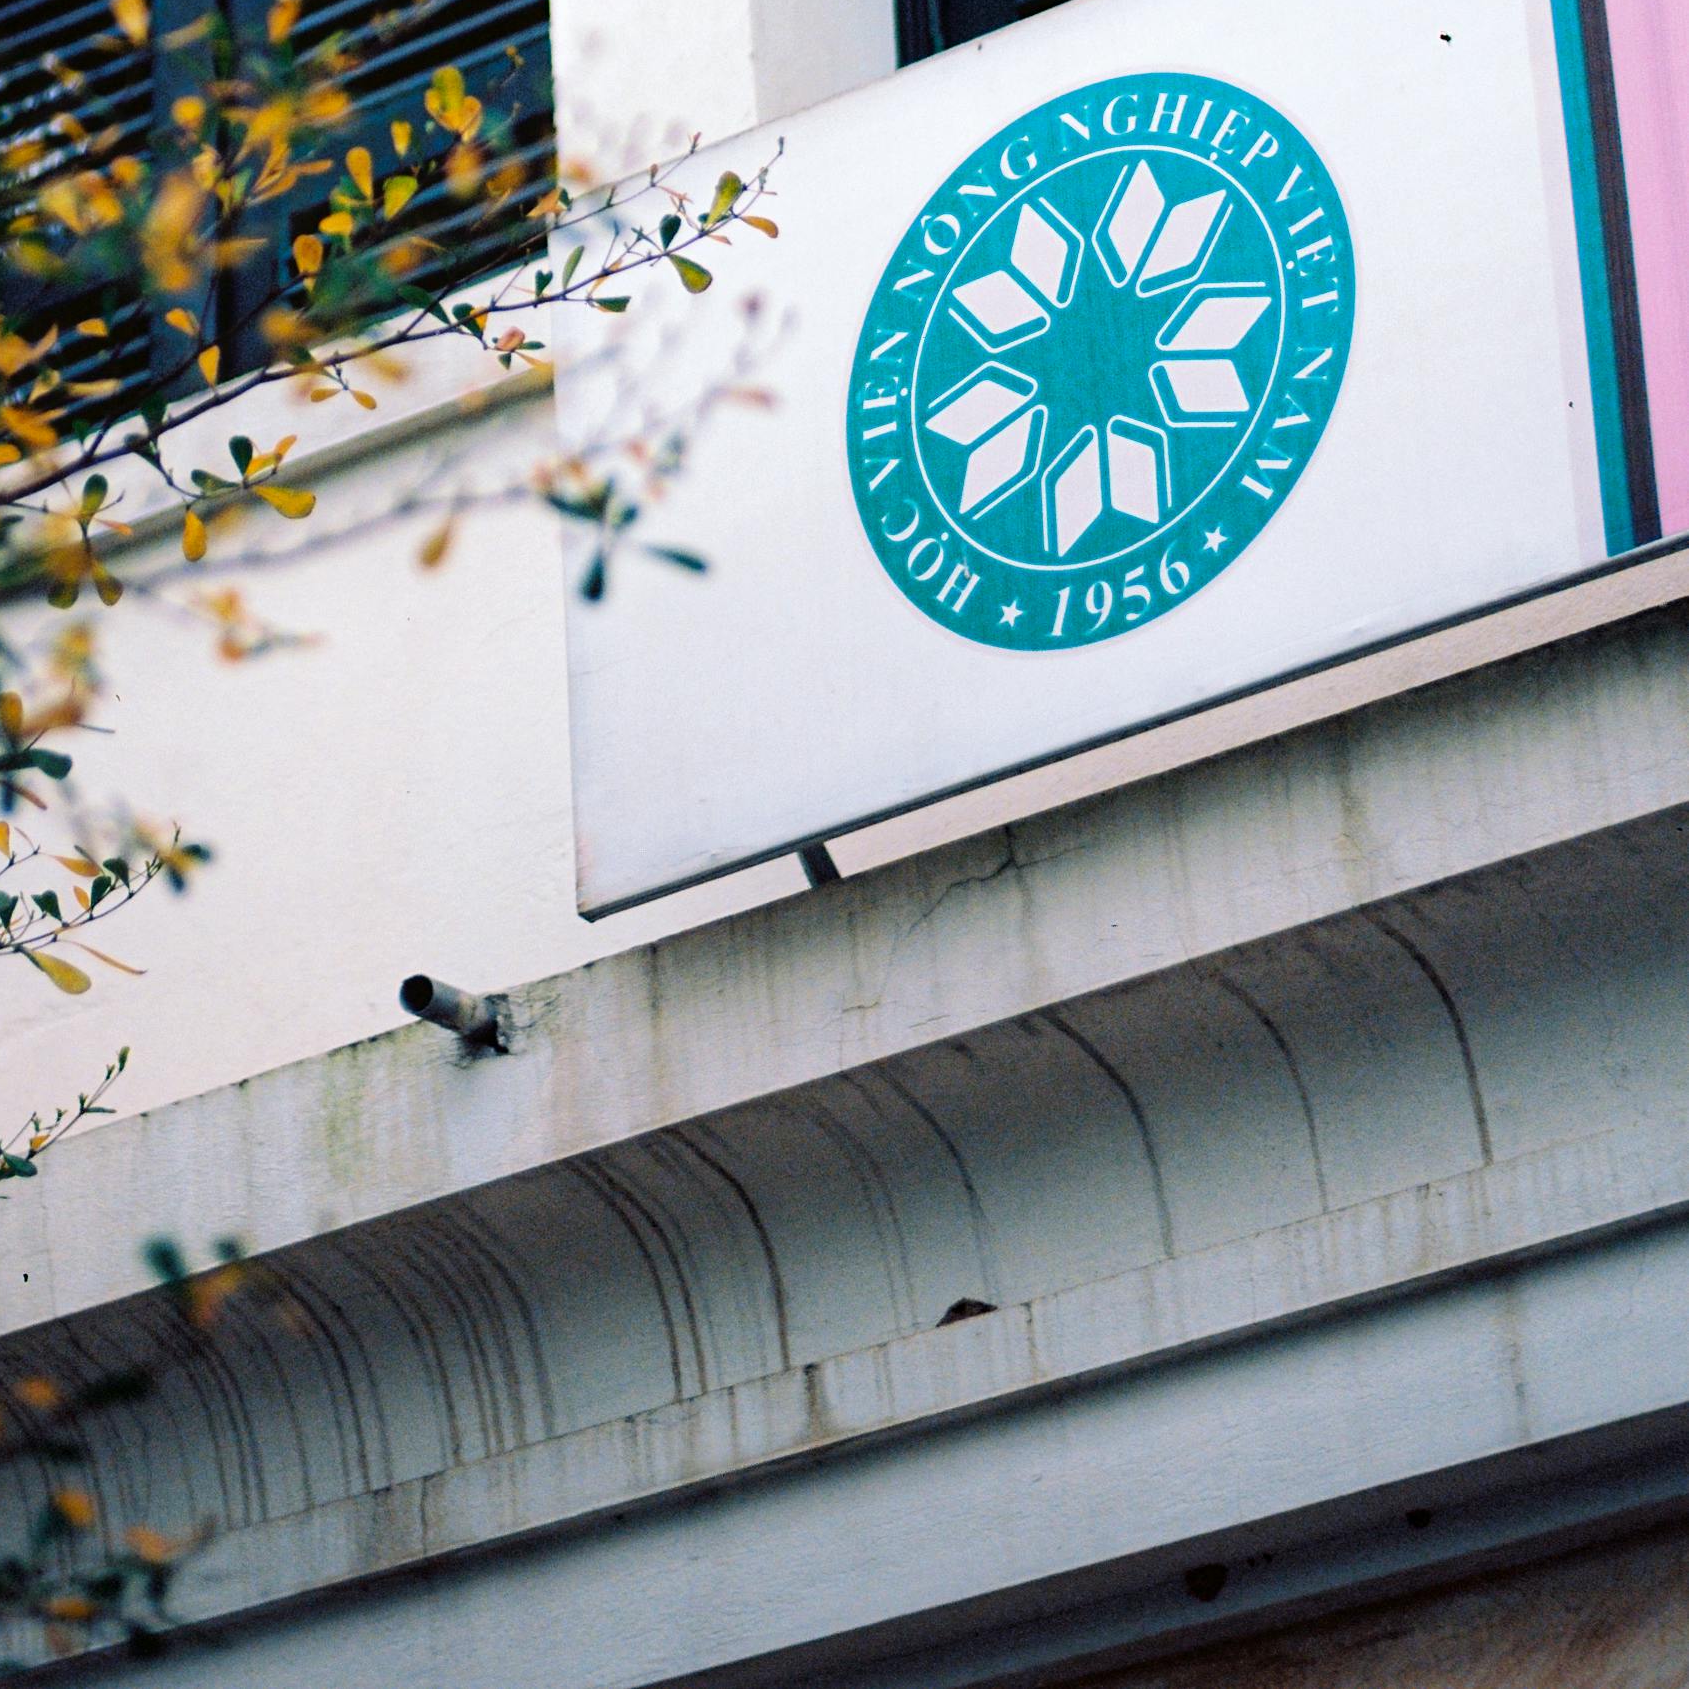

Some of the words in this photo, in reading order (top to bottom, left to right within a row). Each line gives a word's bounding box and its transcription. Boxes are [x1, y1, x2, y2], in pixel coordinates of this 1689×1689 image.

[892, 135, 1038, 302] NÔNG
[1240, 346, 1333, 501] NAM
[880, 499, 980, 613] HỌC
[1048, 540, 1191, 637] 1956
